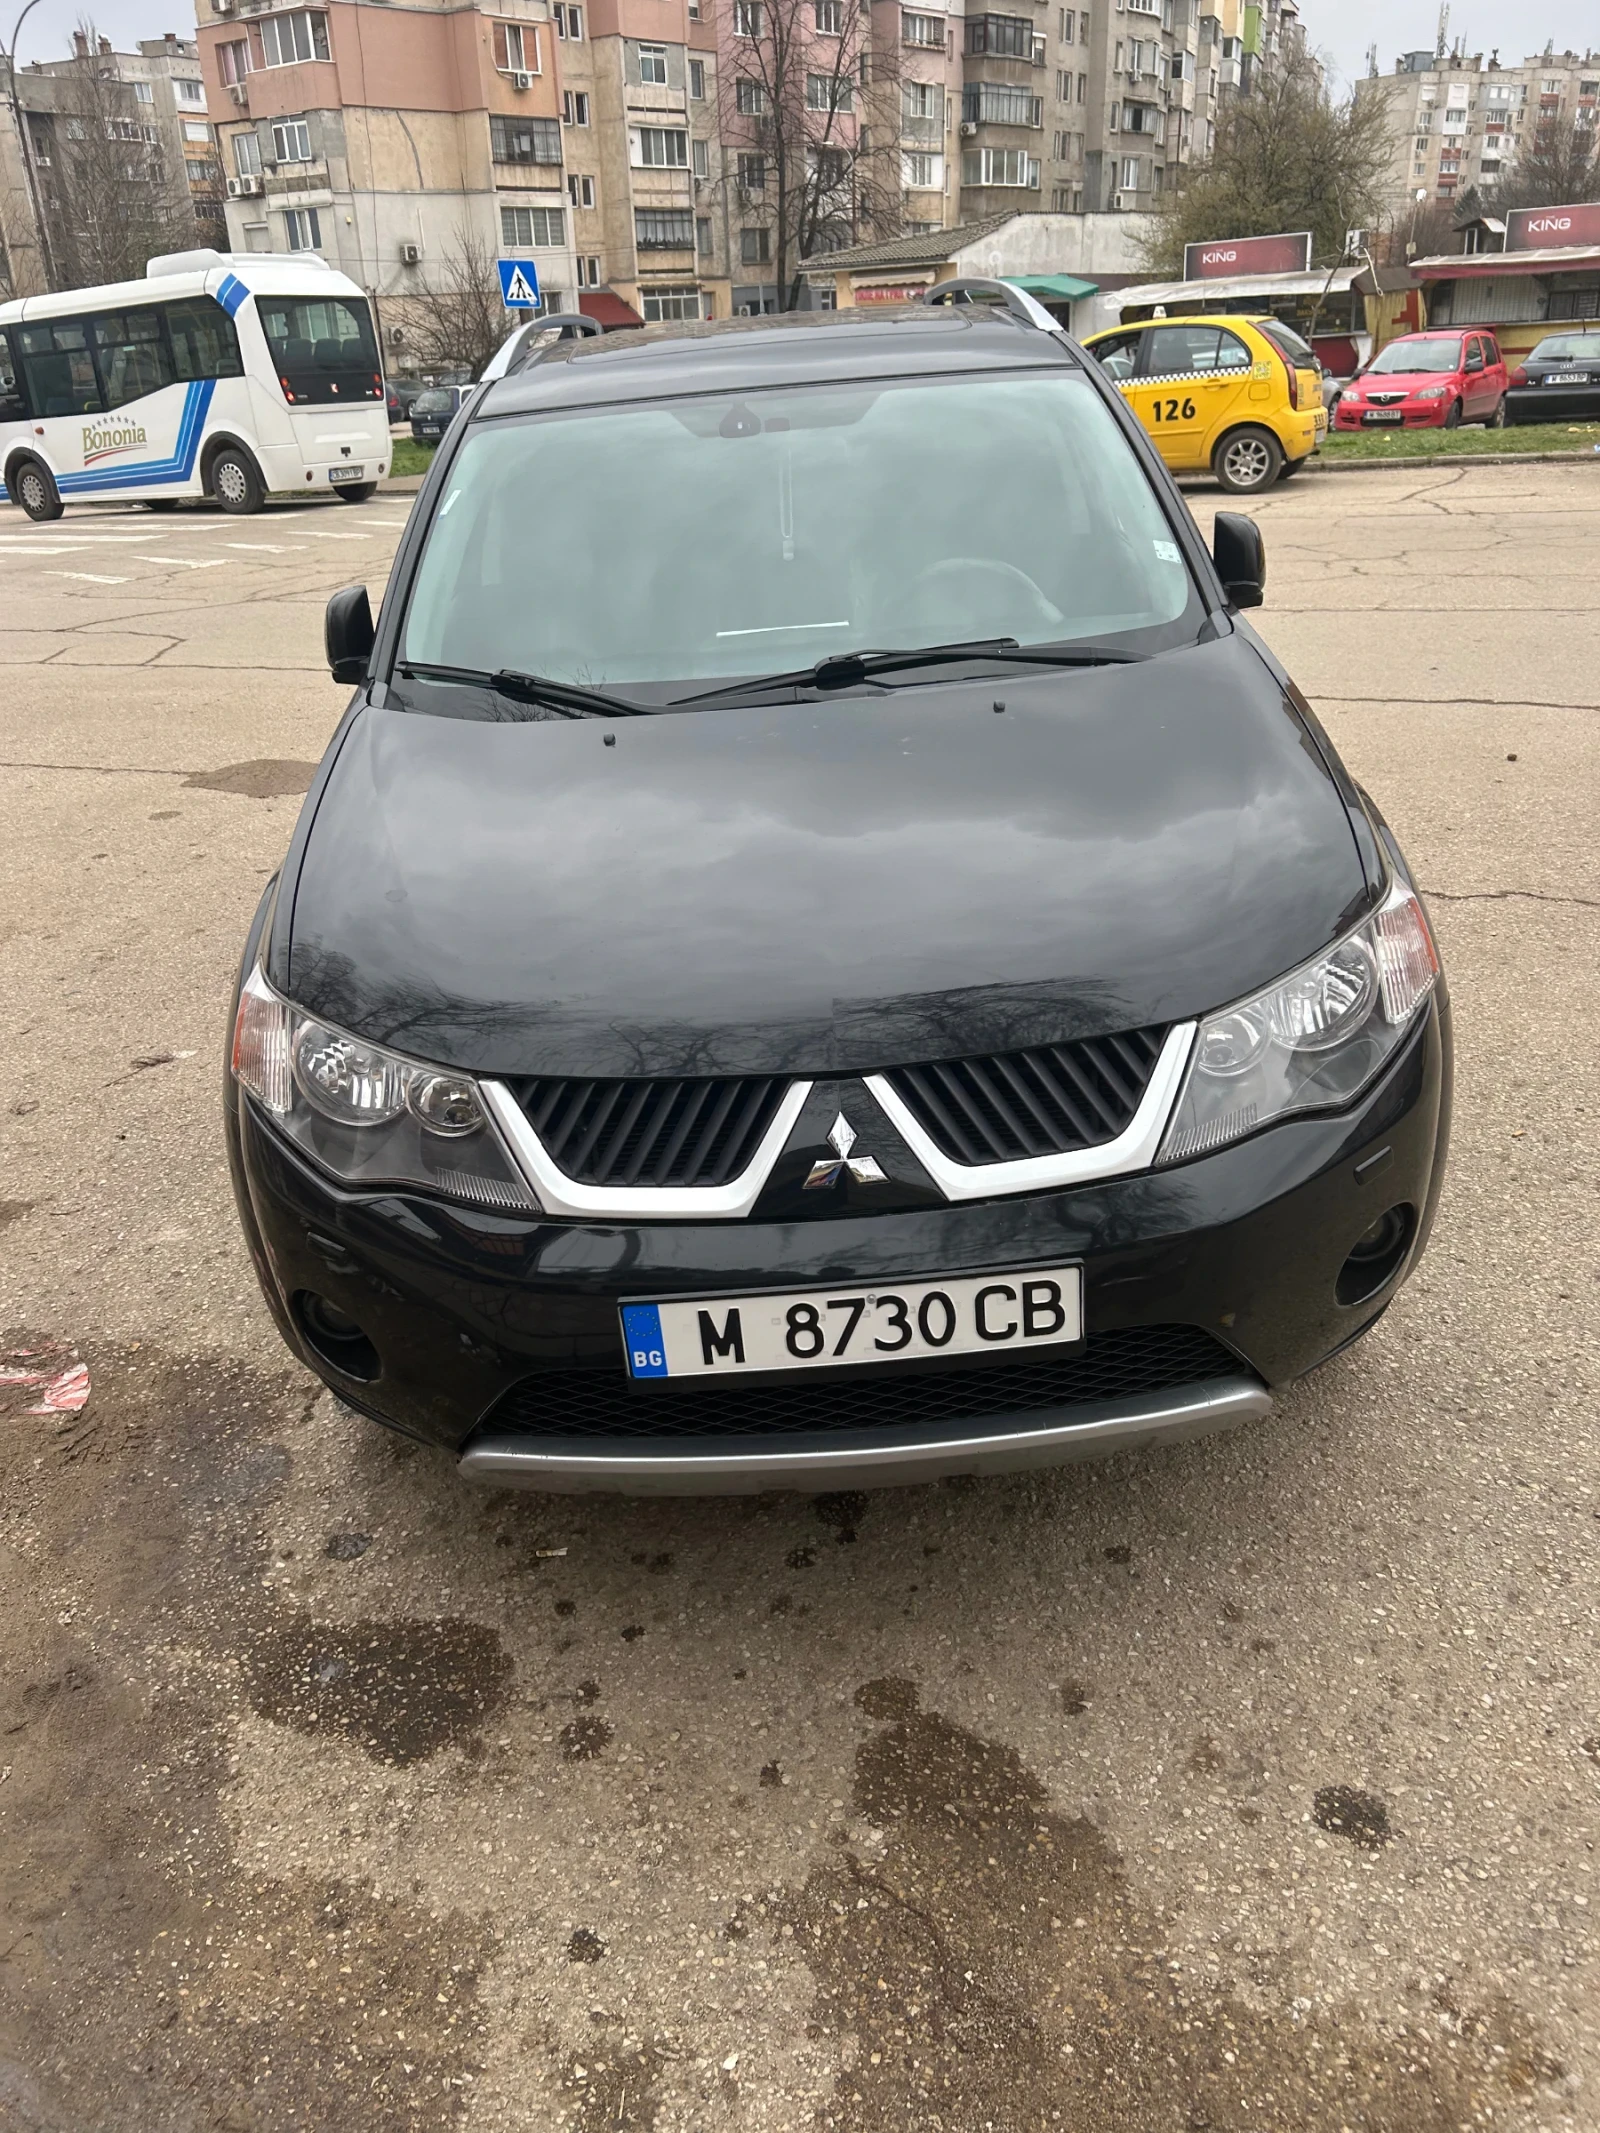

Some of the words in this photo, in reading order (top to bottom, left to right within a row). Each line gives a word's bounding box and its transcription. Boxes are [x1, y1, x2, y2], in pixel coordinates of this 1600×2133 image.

[1527, 217, 1571, 232] KING
[1202, 250, 1237, 264] KING
[1153, 397, 1196, 422] 126
[82, 427, 147, 452] Bononia
[697, 1307, 746, 1366] M
[786, 1290, 956, 1359] 8730
[974, 1279, 1066, 1341] CB
[633, 1350, 662, 1368] BG
